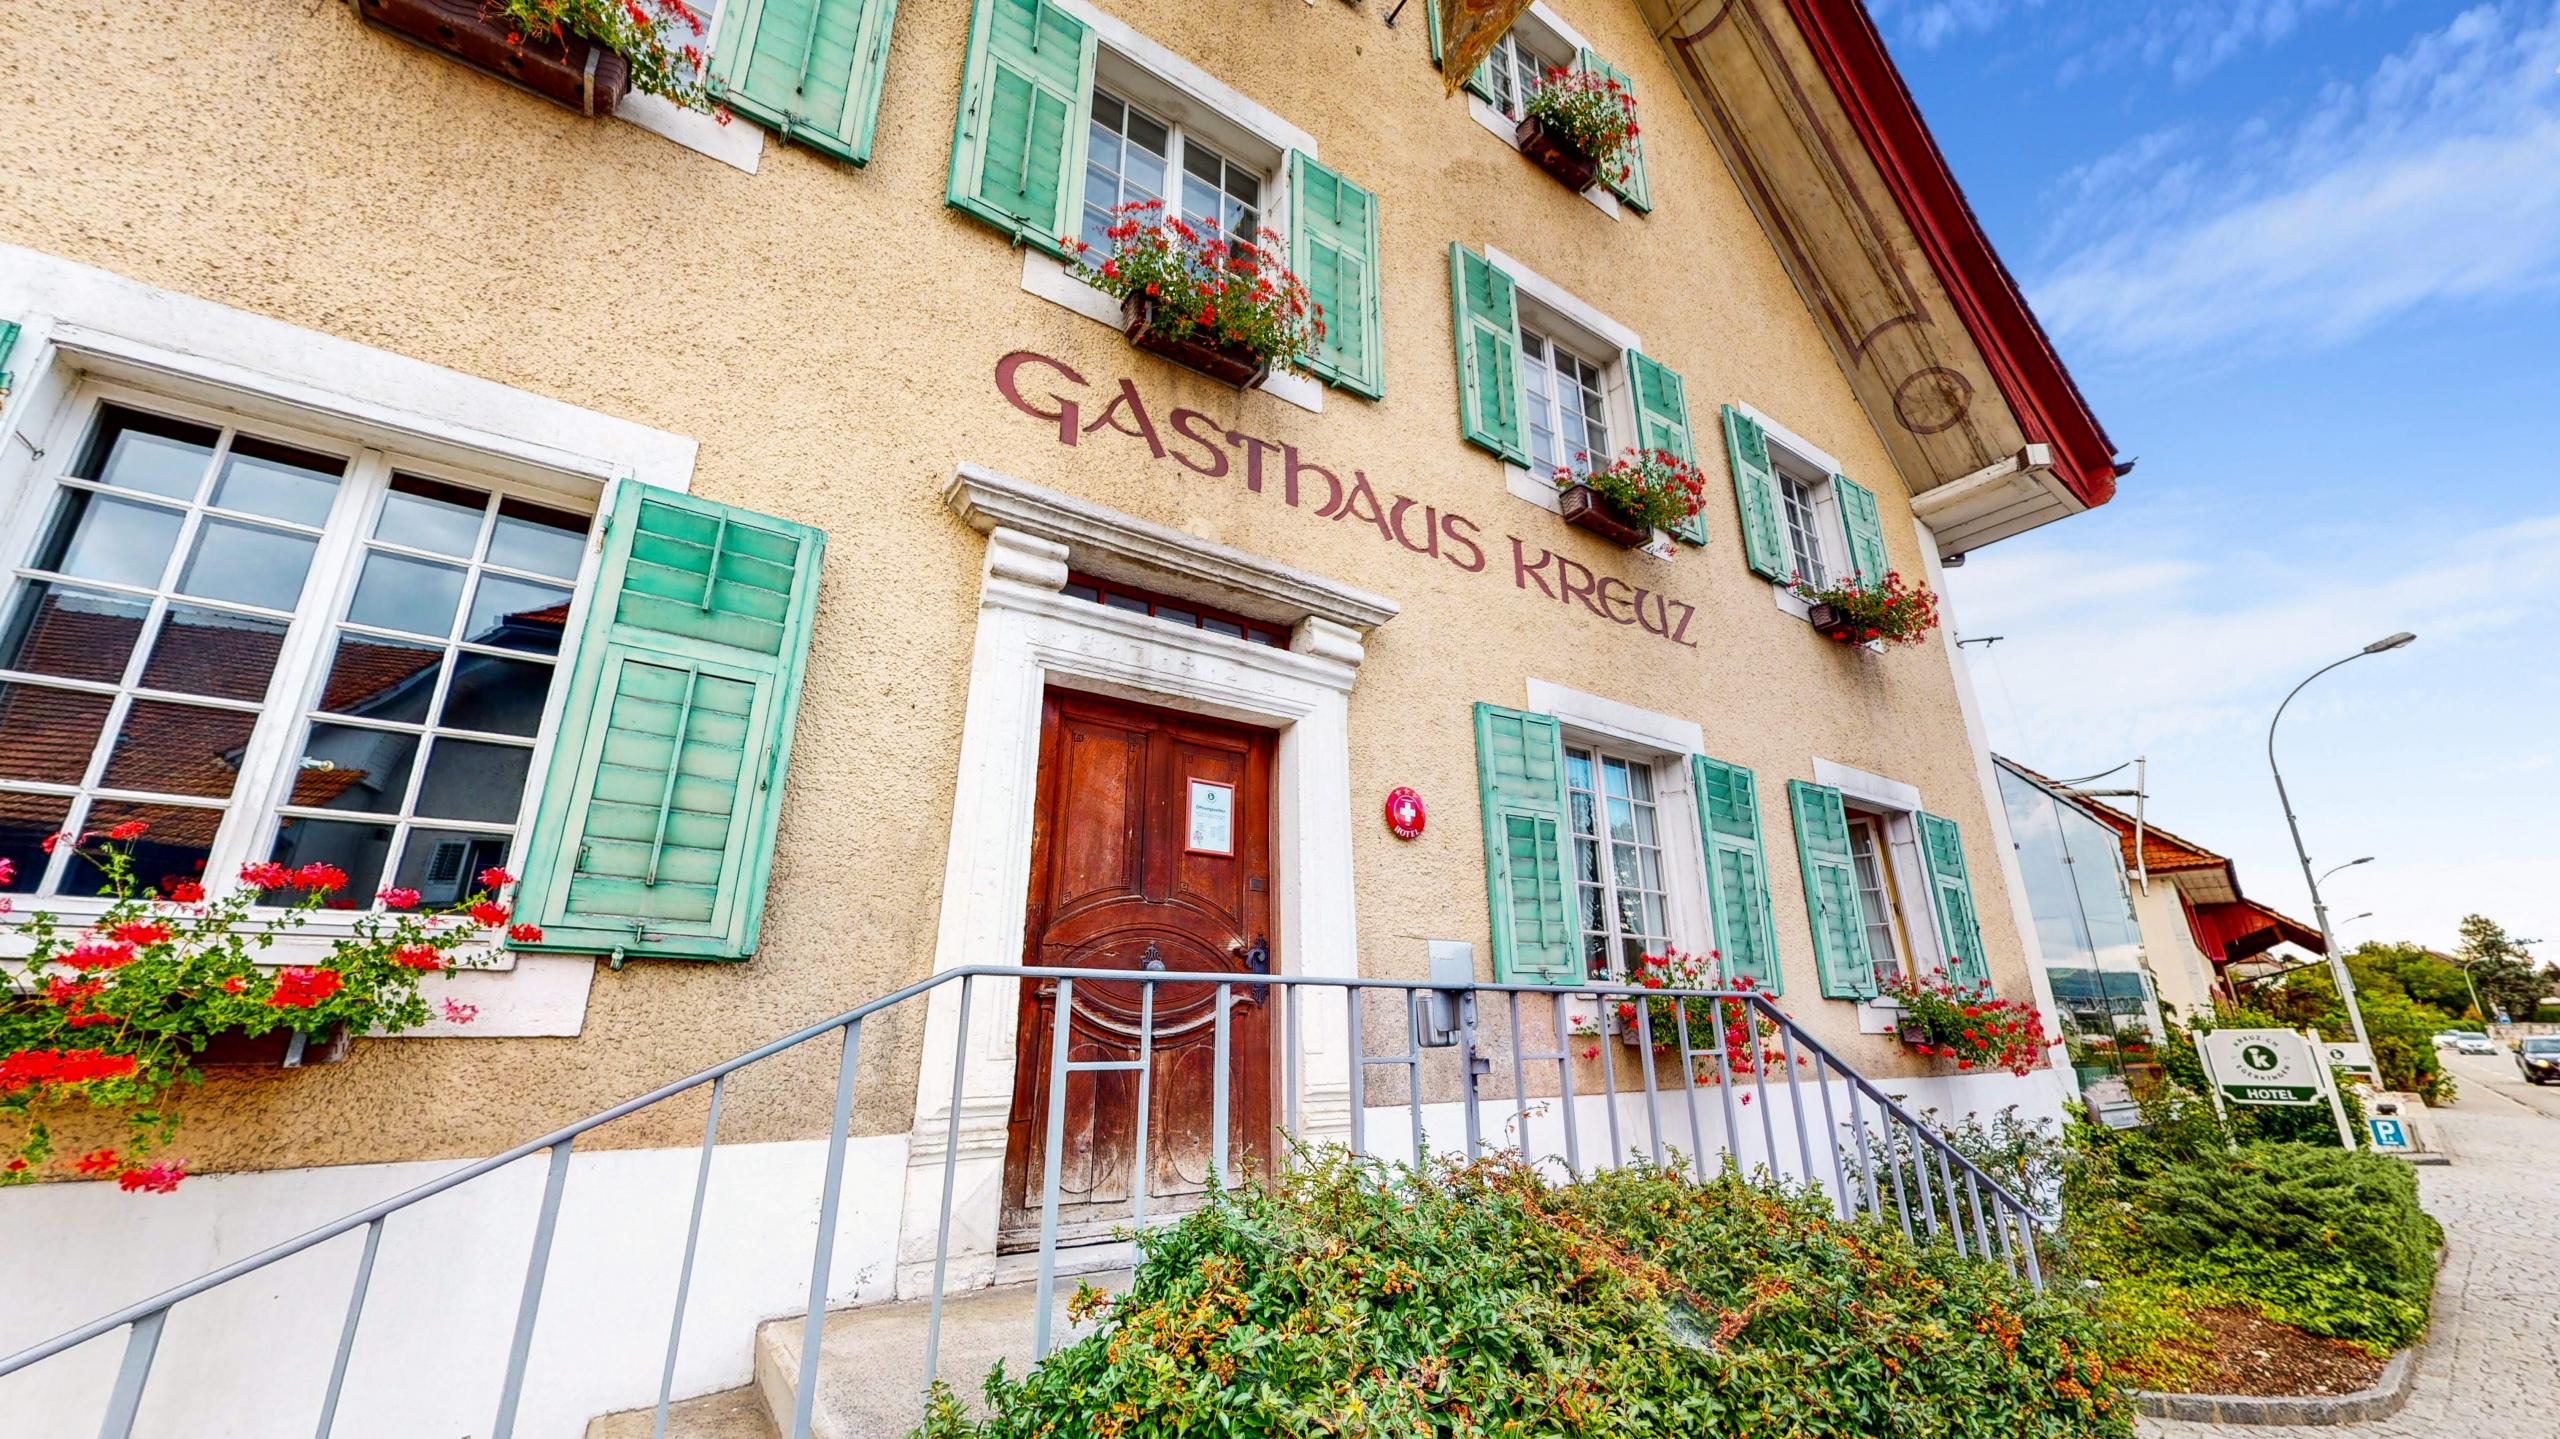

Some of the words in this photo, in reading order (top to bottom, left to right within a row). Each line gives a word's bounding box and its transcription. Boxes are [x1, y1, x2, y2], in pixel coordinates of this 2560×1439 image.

[995, 351, 1485, 572] GASTHAUS
[1507, 535, 1697, 648] KREUZ
[1394, 825, 1420, 838] HOTEL
[2246, 1088, 2298, 1101] HOTEL
[2375, 1121, 2395, 1141] P
